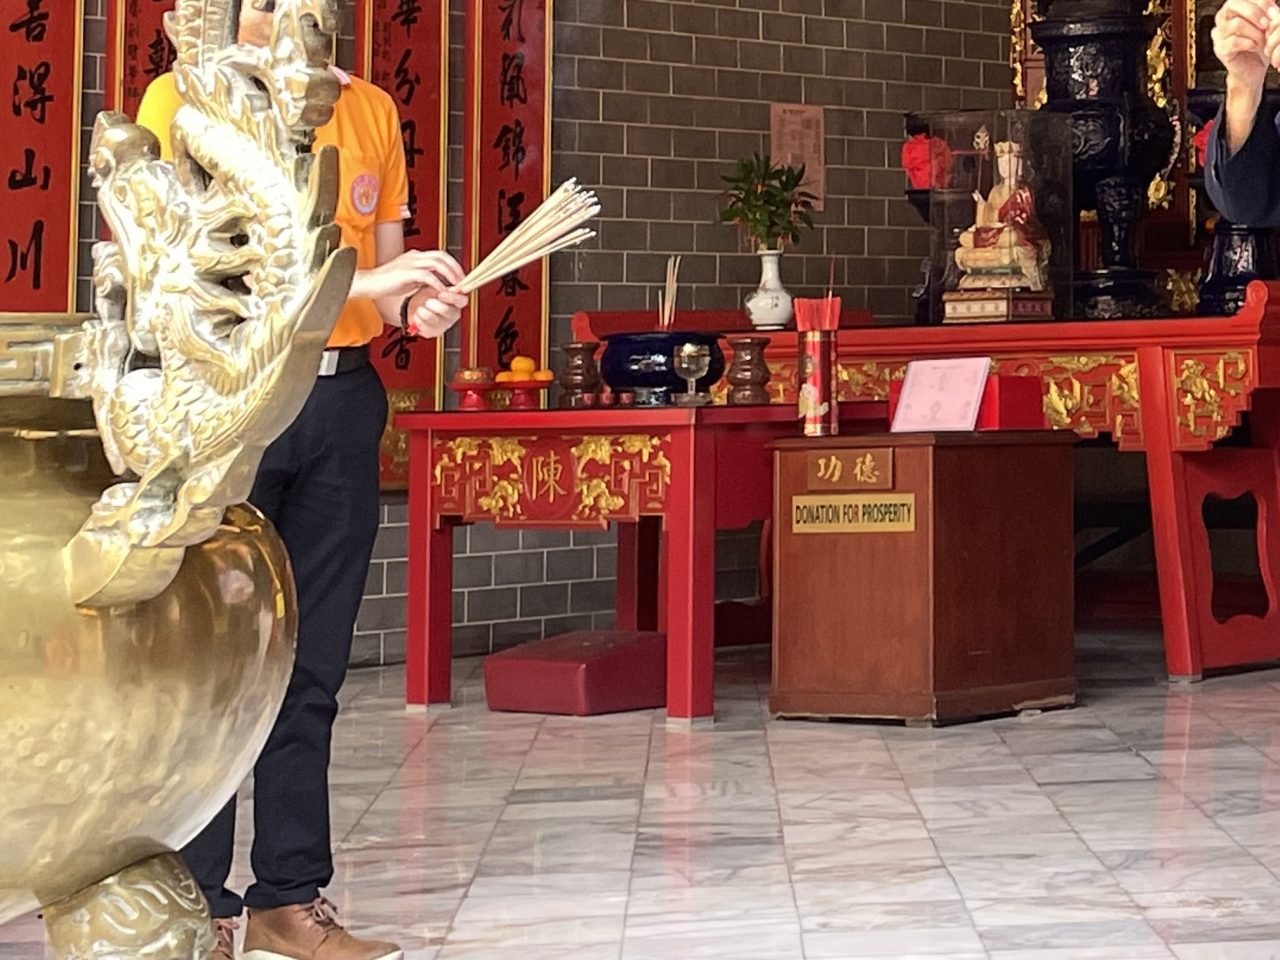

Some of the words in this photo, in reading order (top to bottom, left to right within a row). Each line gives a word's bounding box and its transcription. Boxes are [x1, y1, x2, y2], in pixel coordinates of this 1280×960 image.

[531, 450, 567, 503] 陳
[817, 452, 880, 483] 功德
[795, 505, 840, 524] DONATION
[843, 504, 858, 523] FOR
[862, 503, 912, 523] PROSPERITY
